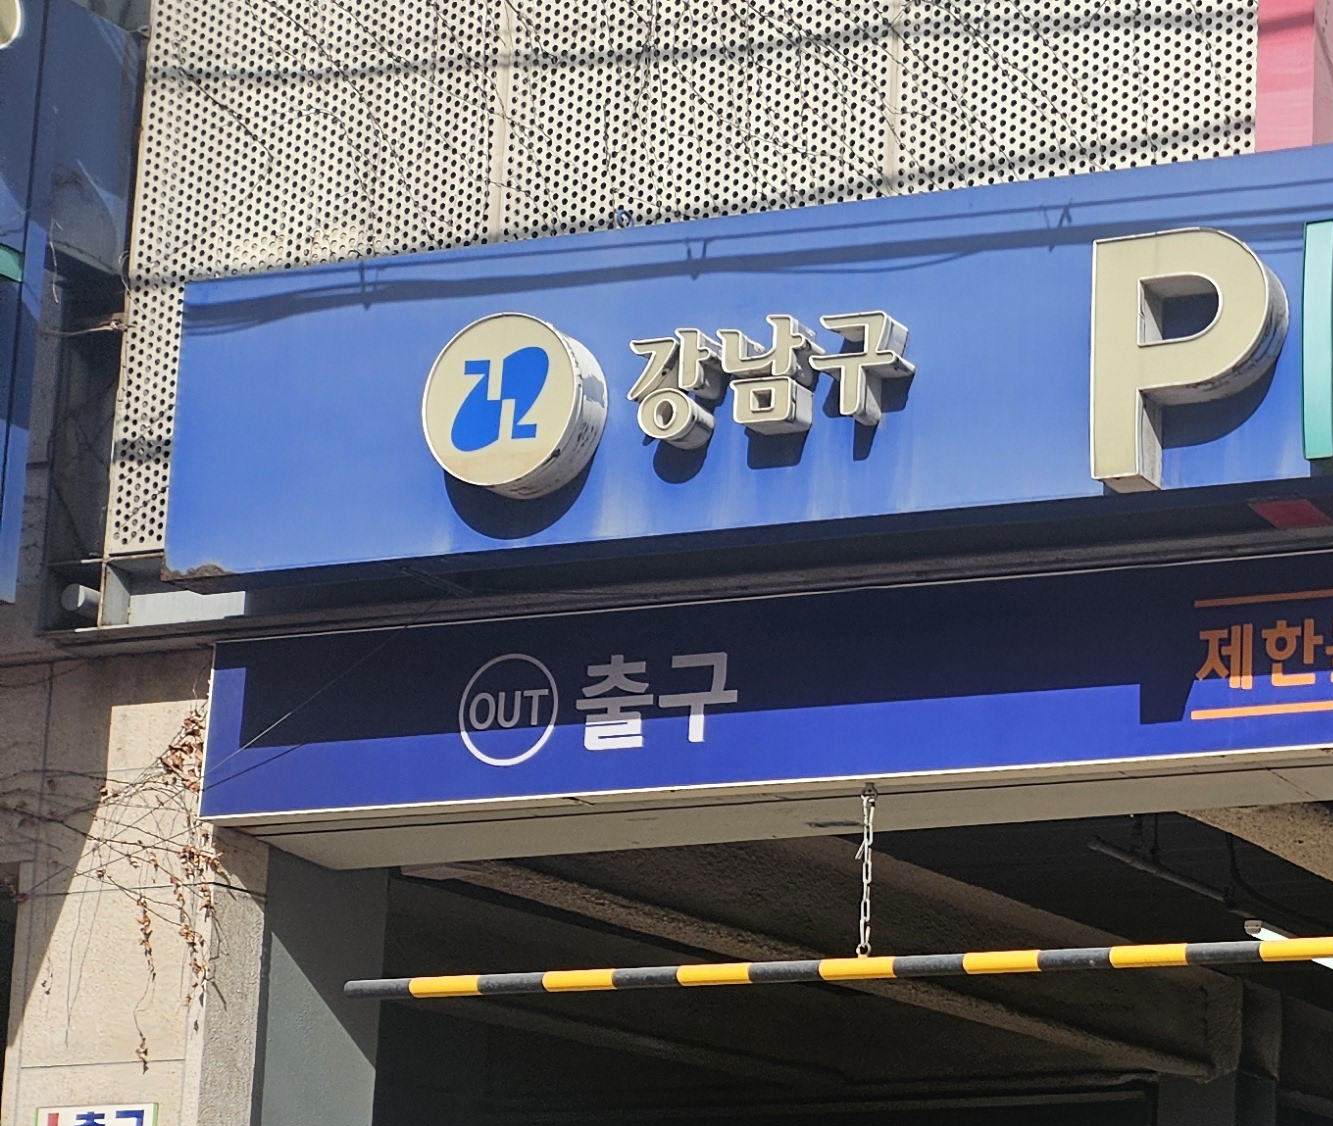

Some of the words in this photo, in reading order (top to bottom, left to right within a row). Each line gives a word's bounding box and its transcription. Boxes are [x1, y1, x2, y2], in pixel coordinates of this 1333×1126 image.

[629, 311, 916, 451] 강남구
[468, 688, 551, 731] OUT
[575, 651, 738, 751] 출구
